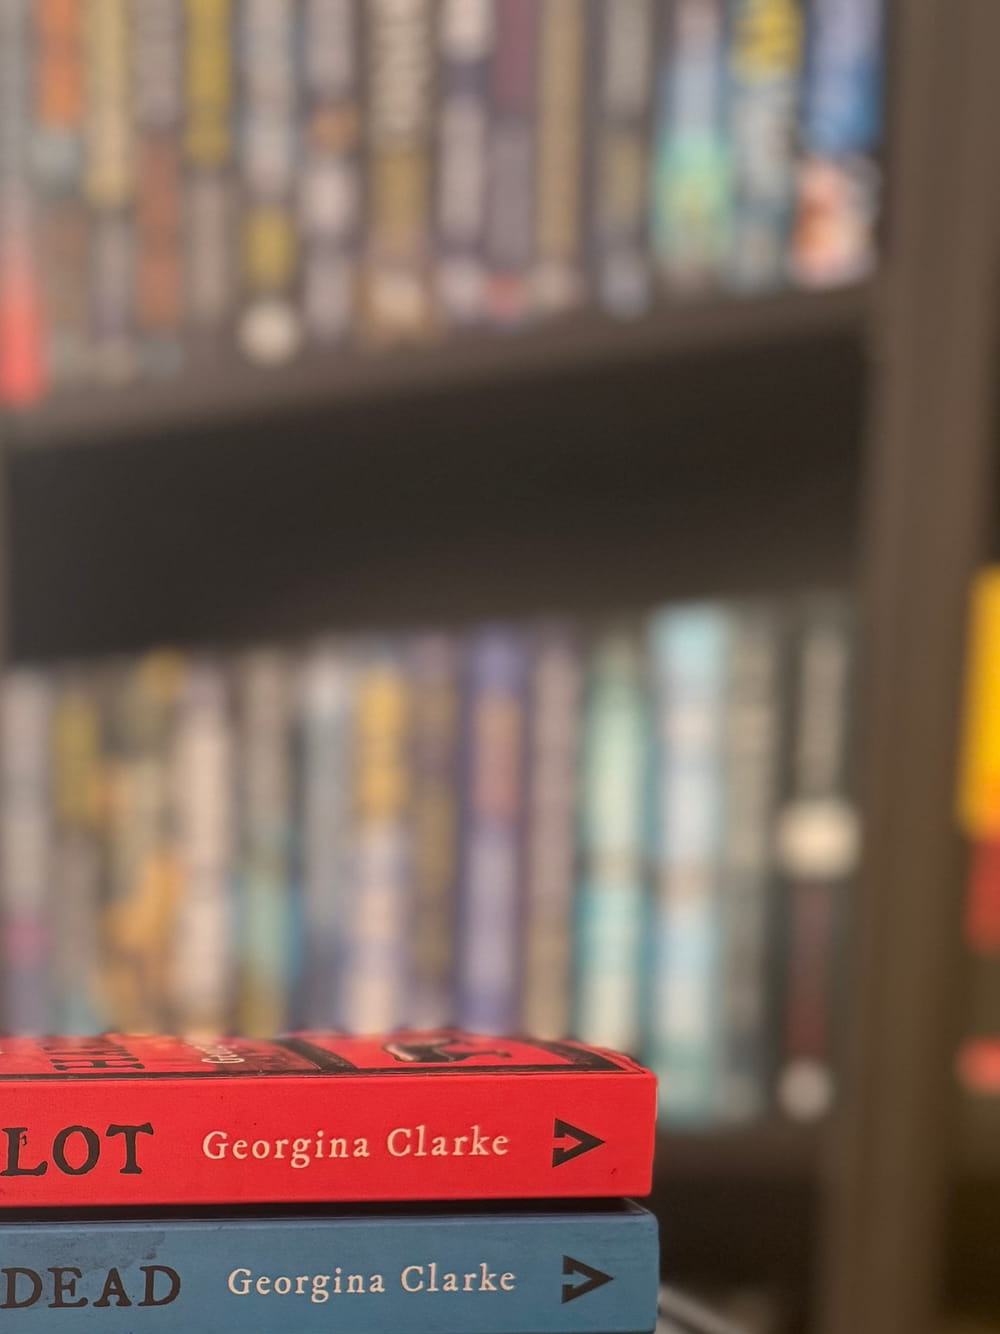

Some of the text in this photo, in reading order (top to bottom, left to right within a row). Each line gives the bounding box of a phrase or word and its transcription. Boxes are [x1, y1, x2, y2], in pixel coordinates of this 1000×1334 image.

[203, 1125, 509, 1168] Georgina Clarke
[0, 1265, 181, 1309] DEAD
[227, 1263, 516, 1303] Georgina Clarke
